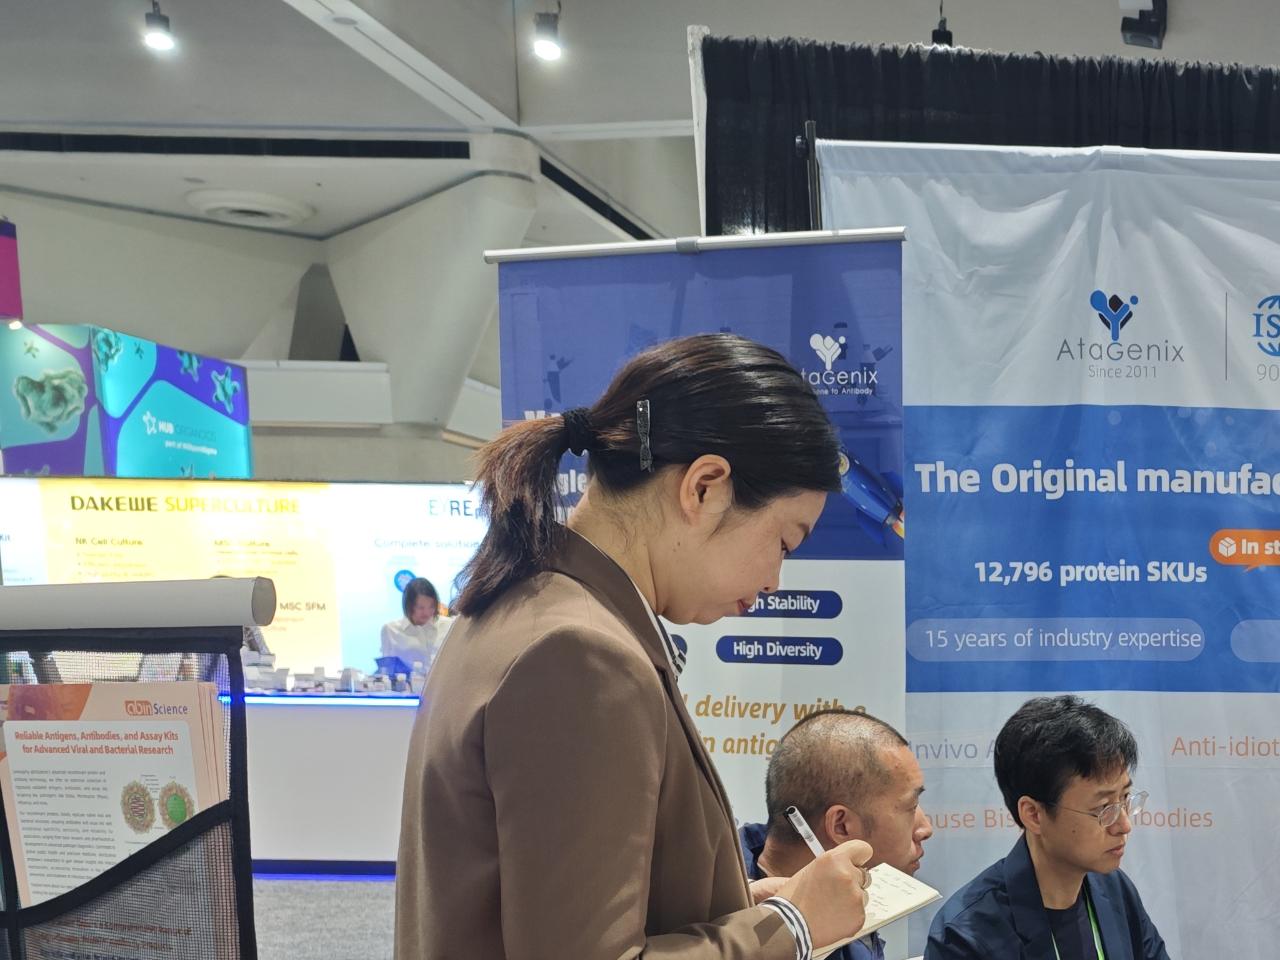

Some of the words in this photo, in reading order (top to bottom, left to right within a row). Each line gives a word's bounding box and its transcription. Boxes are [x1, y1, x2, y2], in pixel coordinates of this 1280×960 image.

[1057, 338, 1184, 362] AtaGenix
[801, 367, 877, 384] taGenix
[1089, 365, 1122, 378] Since
[1126, 366, 1157, 378] 2011
[914, 463, 980, 493] The
[992, 460, 1127, 499] Original
[71, 496, 157, 511] DAKEWE
[1241, 539, 1258, 554] In
[975, 561, 1052, 585] 12,796
[1061, 559, 1139, 586] protein
[1147, 561, 1207, 582] SKUs
[768, 595, 819, 613] Stability
[926, 630, 948, 647] 15
[955, 631, 1006, 651] years
[1014, 628, 1034, 647] of
[1039, 628, 1112, 651] industry
[1118, 630, 1201, 650] expertise
[733, 641, 762, 659] High
[766, 642, 823, 660] Diversity
[125, 701, 187, 715] abinScience
[695, 695, 786, 724] delivery
[15, 731, 43, 740] Reliable
[45, 731, 79, 741] Antigens,
[81, 731, 122, 741] Antibodies,
[124, 732, 138, 740] and
[140, 732, 162, 742] Assay
[164, 732, 178, 740] Kits
[22, 745, 33, 753] for
[34, 745, 70, 753] Advanced
[71, 745, 86, 753] Viral
[87, 745, 103, 753] and
[105, 745, 137, 754] Bacterial
[139, 746, 173, 755] Research
